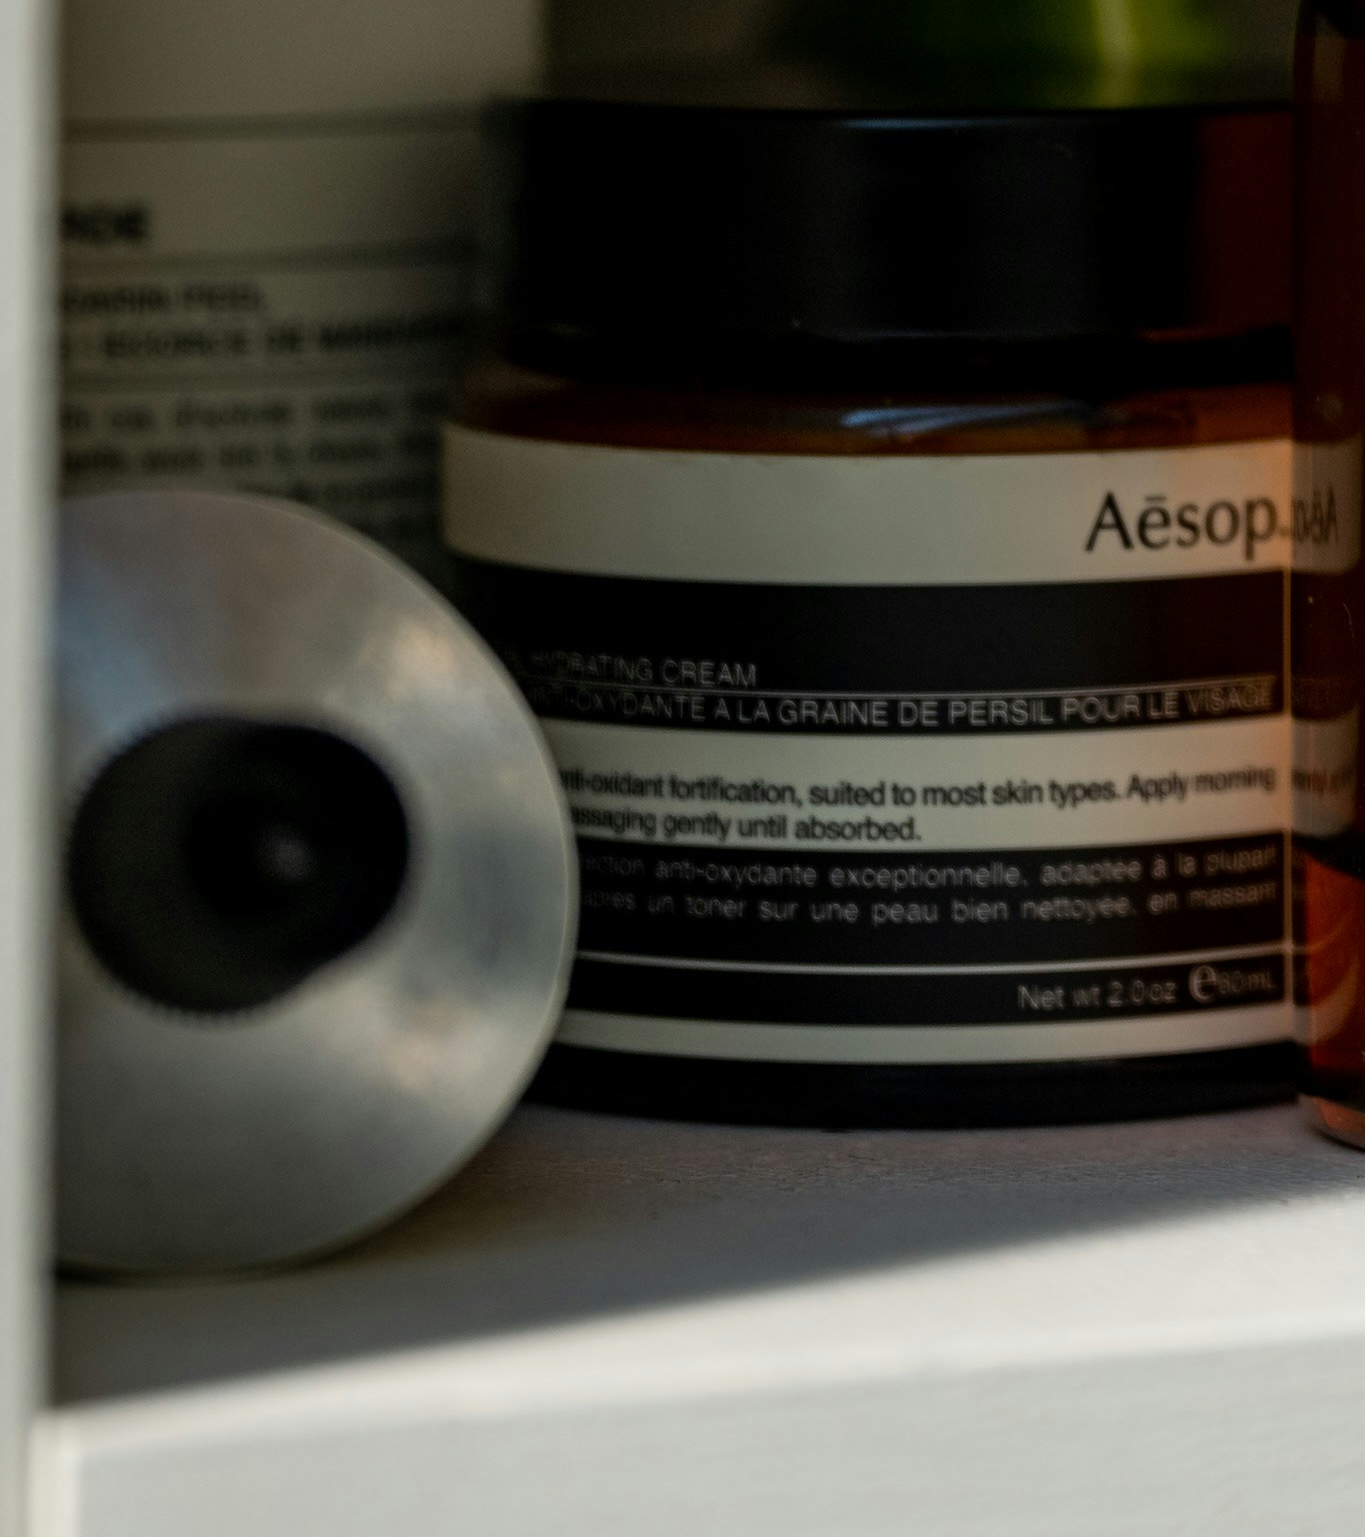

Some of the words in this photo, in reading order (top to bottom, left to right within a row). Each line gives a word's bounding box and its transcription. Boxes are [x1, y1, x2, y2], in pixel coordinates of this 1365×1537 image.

[660, 658, 758, 688] CREAM
[738, 699, 771, 725] LA
[777, 699, 890, 727] GRAINE
[899, 701, 939, 727] DE
[948, 698, 1055, 727] PERSIL
[1061, 694, 1141, 724] POUR
[1149, 691, 1181, 720] LE
[1187, 682, 1274, 717] VISAGE
[669, 773, 803, 809] fortification,
[809, 780, 887, 807] suited
[891, 782, 918, 807] to
[923, 778, 989, 807] most
[992, 774, 1045, 805] skin
[1049, 775, 1121, 810] types.
[1127, 772, 1189, 807] Apply
[1194, 765, 1277, 797] morning
[663, 810, 733, 844] gently
[738, 813, 788, 840] until
[795, 815, 922, 843] absorbed.
[654, 857, 818, 892] anti-oxydante
[685, 892, 748, 920] toner
[757, 899, 800, 922] sur
[810, 901, 860, 924] une
[872, 901, 938, 928] peau
[951, 896, 1010, 924] bien
[1146, 889, 1178, 915] en
[1018, 983, 1065, 1011] Net
